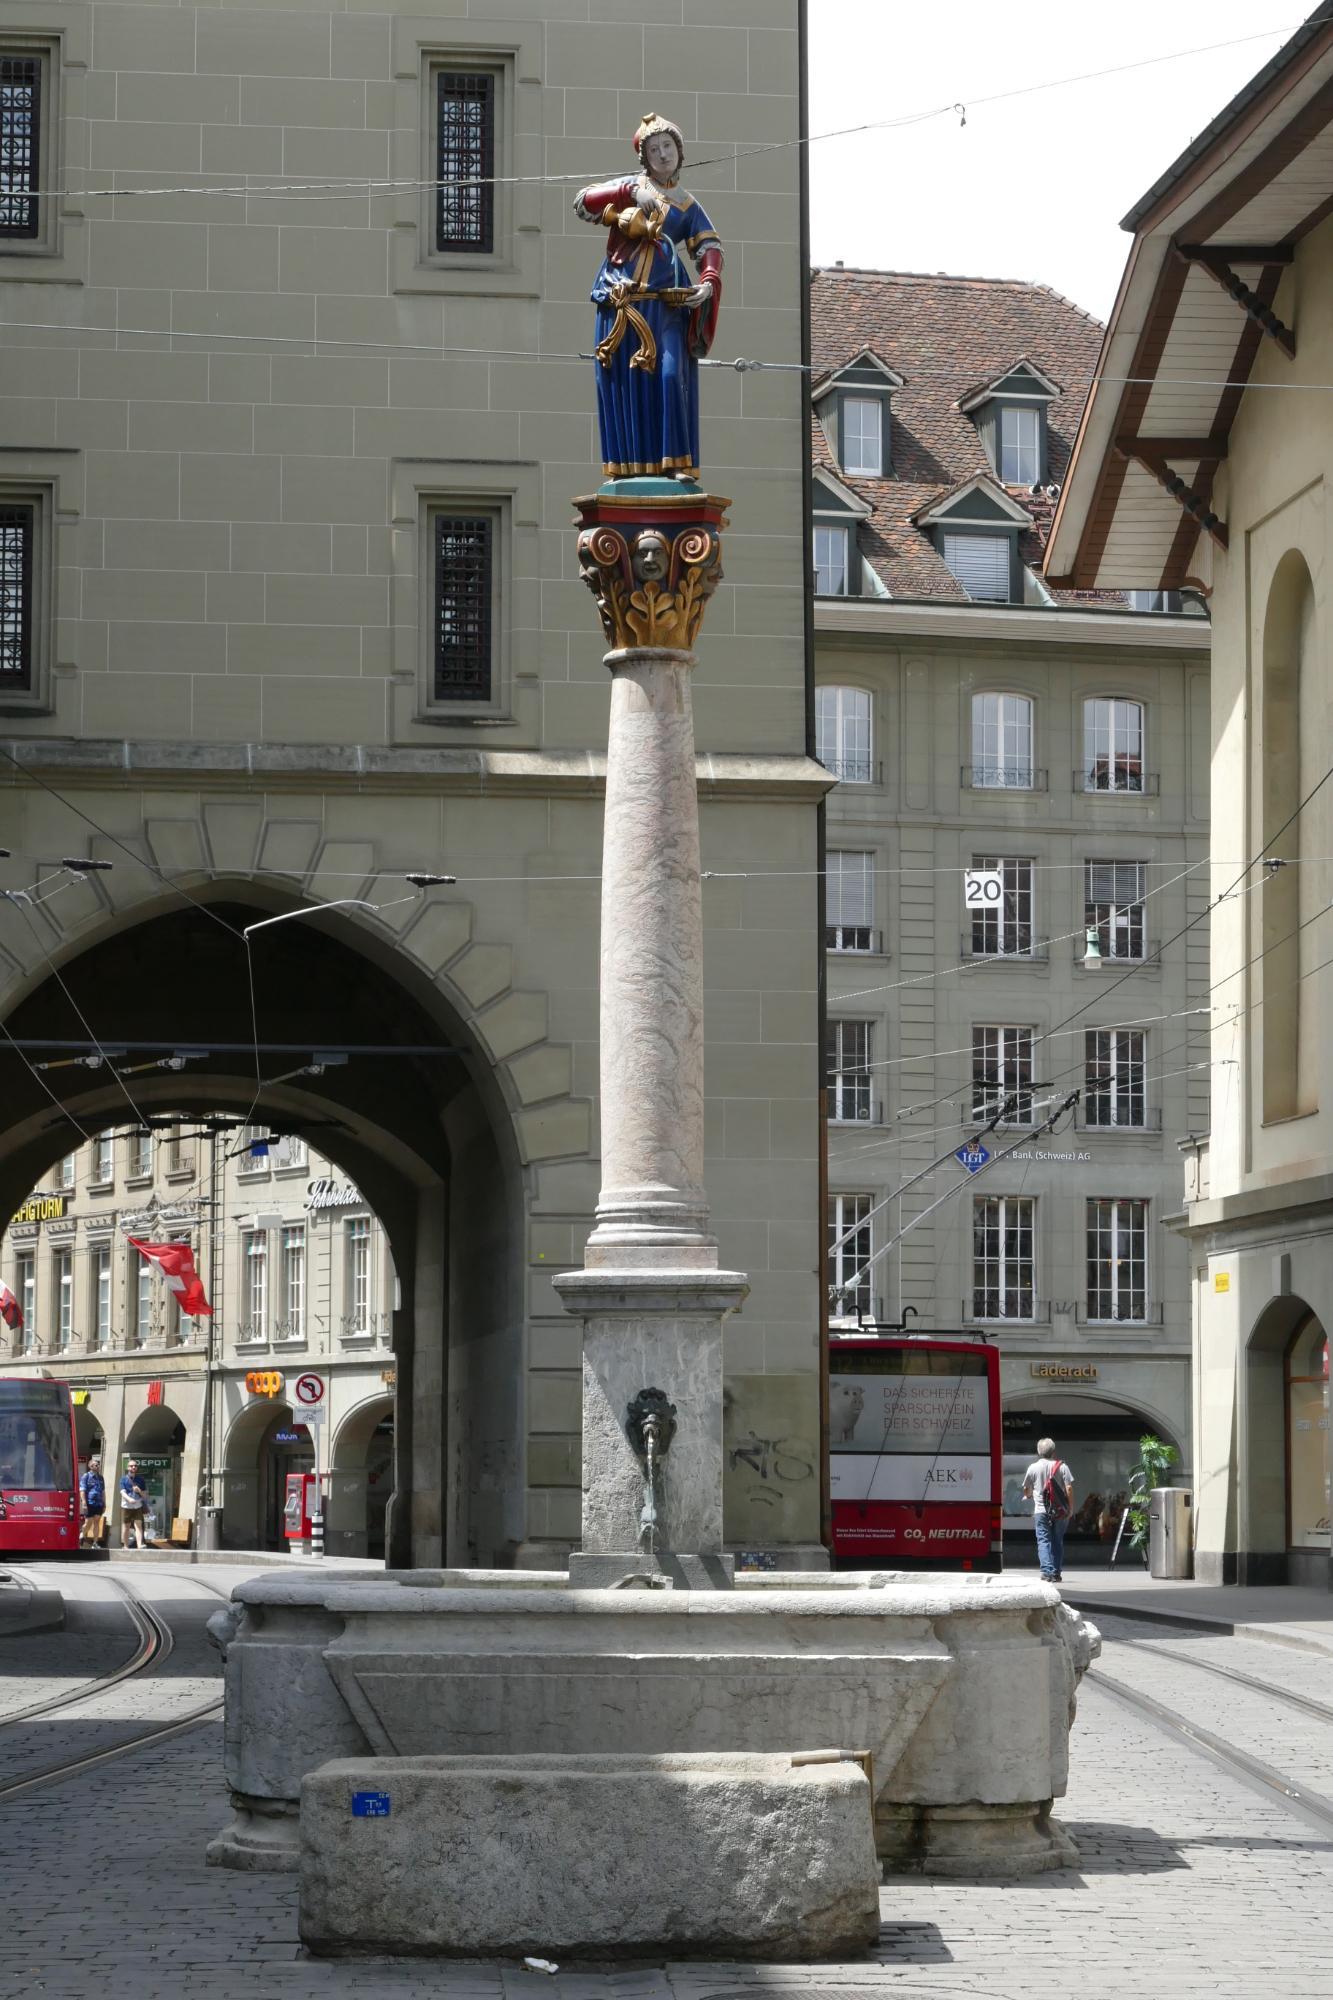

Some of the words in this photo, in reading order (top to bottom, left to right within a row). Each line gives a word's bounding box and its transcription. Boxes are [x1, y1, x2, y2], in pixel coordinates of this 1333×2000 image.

[967, 880, 1001, 901] 20
[962, 1152, 985, 1163] LGT
[1035, 1151, 1076, 1161] (Schweiz)
[1077, 1152, 1091, 1160] AG
[1030, 1362, 1098, 1377] Läderach
[245, 1371, 281, 1399] coop
[883, 1387, 907, 1399] DAS
[911, 1387, 975, 1399] SICHERSTE
[883, 1402, 975, 1415] SPARSCHWEIN
[883, 1417, 910, 1430] DER
[923, 1469, 956, 1482] AEK
[13, 1495, 29, 1503] 652
[928, 1529, 985, 1539] NEUTRAL
